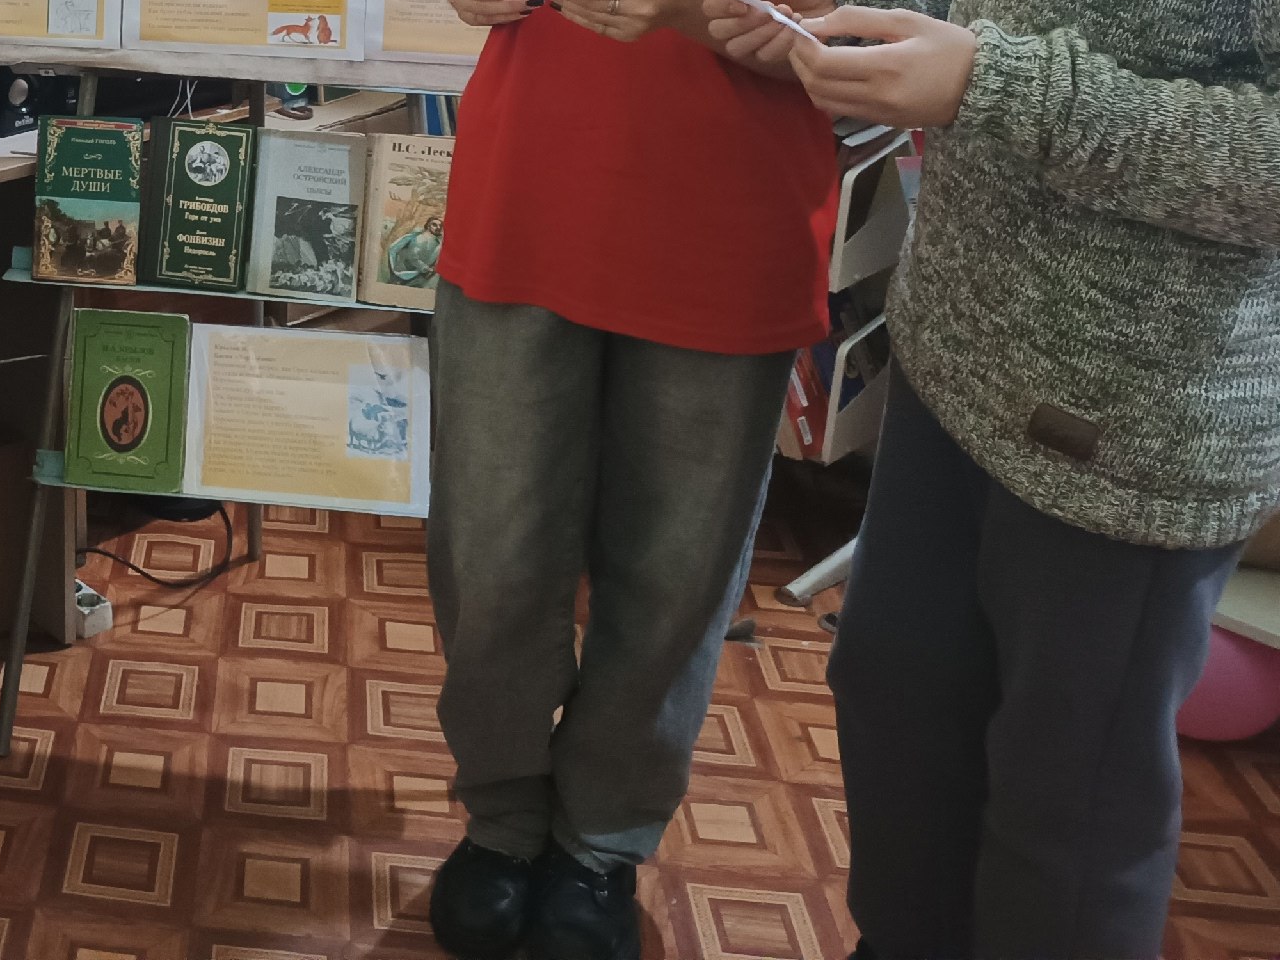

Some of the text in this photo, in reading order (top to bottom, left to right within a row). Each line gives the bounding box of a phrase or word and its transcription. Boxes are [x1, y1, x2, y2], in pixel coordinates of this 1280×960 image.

[392, 142, 417, 154] Н.С.
[61, 165, 123, 181] МЕРТВЫЕ
[296, 166, 345, 176] АЛЕКСАНДР
[292, 173, 347, 186] ОСТРОВСКИЙ
[70, 180, 110, 193] ДУШИ
[179, 199, 229, 214] ГРИБОЕДОВ
[176, 233, 225, 247] ФОНВИЗИН
